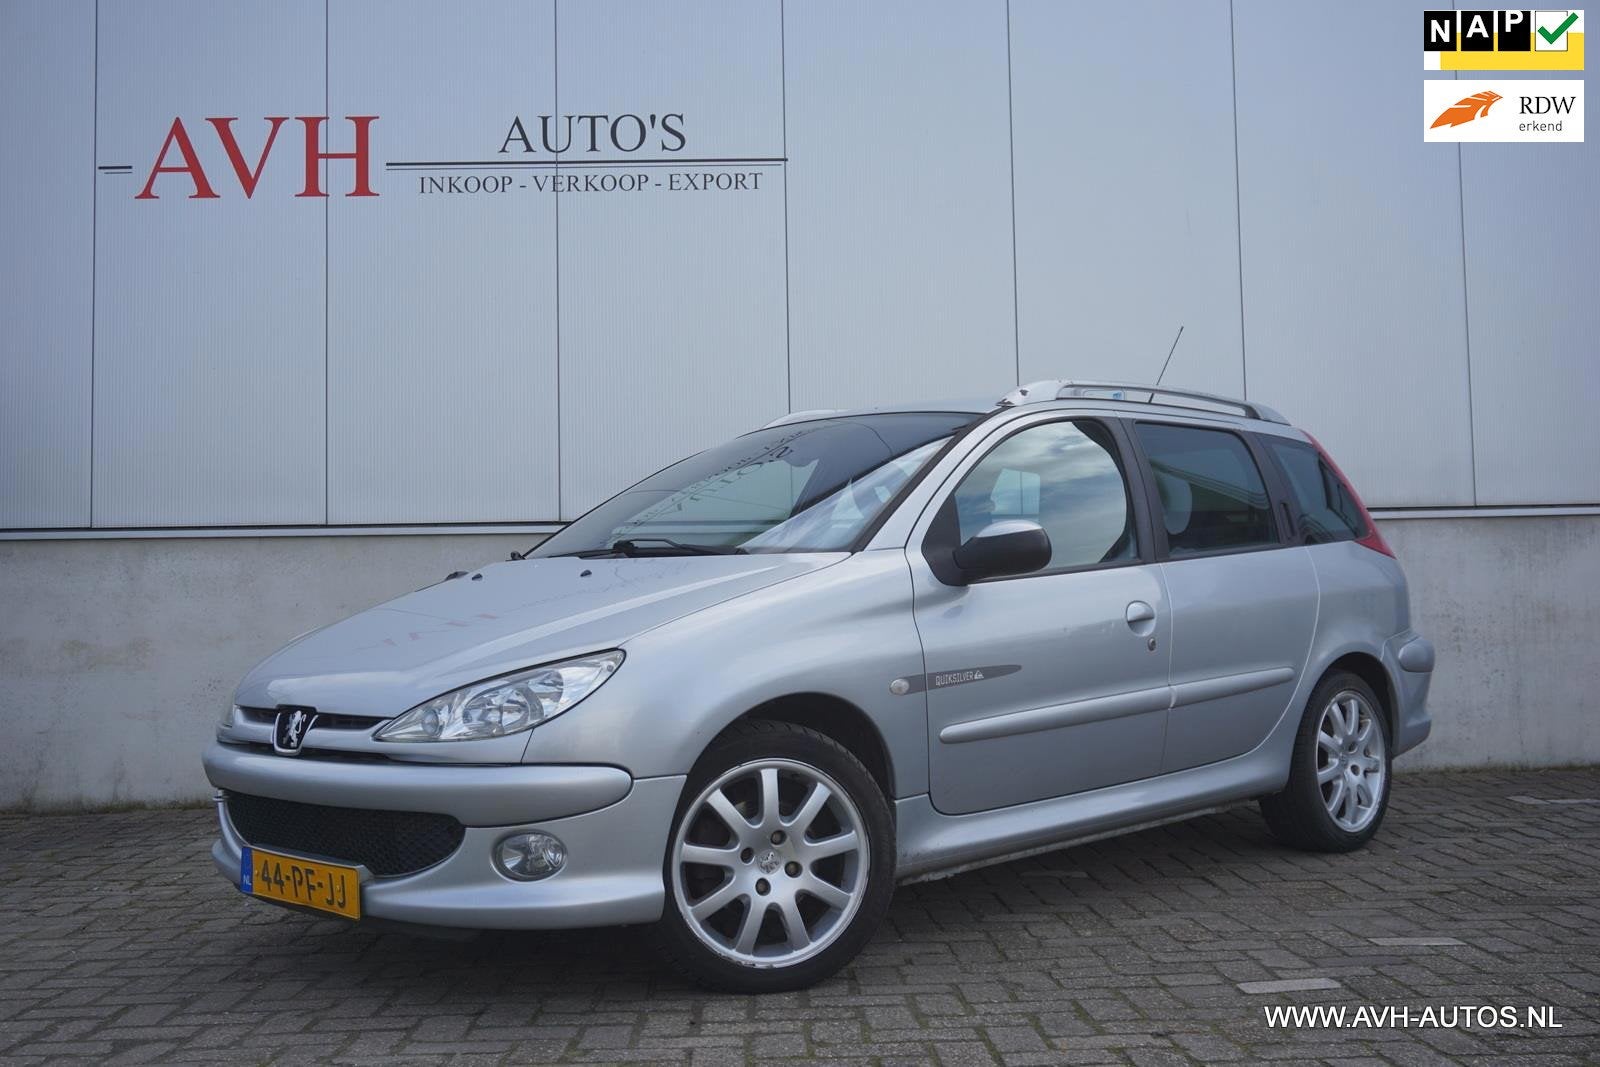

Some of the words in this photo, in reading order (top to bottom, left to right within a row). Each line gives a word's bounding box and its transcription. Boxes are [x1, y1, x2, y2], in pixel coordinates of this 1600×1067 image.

[498, 113, 687, 153] AUTO'S
[134, 116, 380, 199] AVH
[419, 175, 513, 194] INKOOP
[533, 173, 649, 193] VERKOOP
[668, 172, 763, 192] EXPORT
[935, 671, 974, 686] QUIKSILVER
[243, 875, 252, 886] NL
[261, 859, 346, 909] 44-PF-JJ
